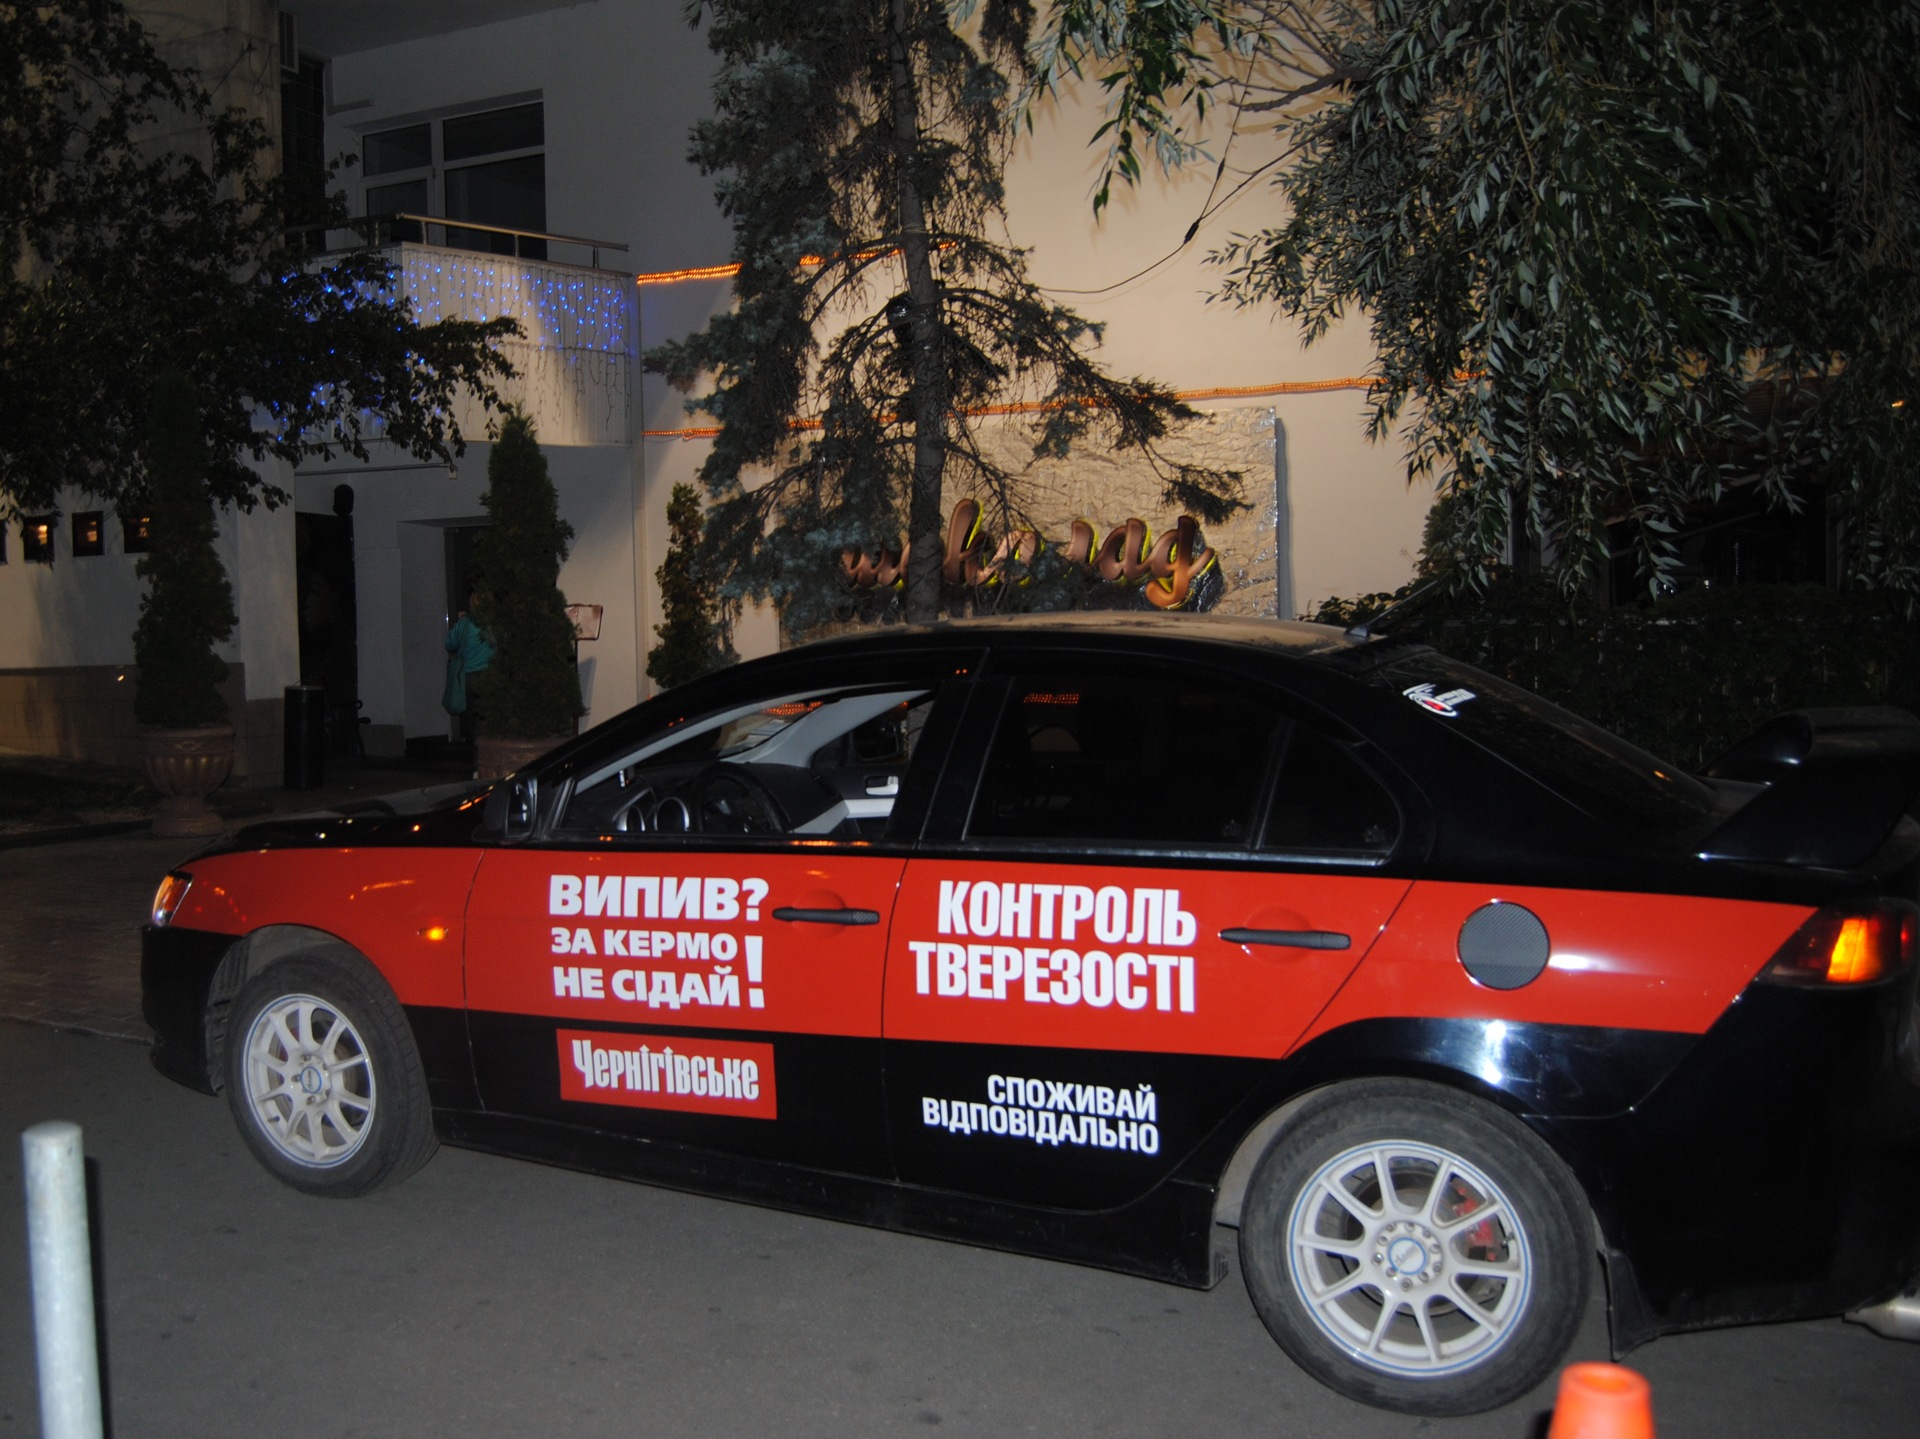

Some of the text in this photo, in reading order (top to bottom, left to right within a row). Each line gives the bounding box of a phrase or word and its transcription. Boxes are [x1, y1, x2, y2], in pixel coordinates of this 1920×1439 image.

[549, 875, 770, 921] ВИПИВ?
[938, 880, 1196, 946] КОНТРОЛЬ
[551, 927, 738, 961] ЗА КЕРМО
[553, 967, 605, 998] НЕ
[612, 965, 740, 1009] СІДАЙ
[909, 941, 1195, 1012] ТВЕРЕЗОСТІ
[572, 1040, 760, 1100] Чернігівське
[987, 1074, 1156, 1121] СПОЖИВАЙ
[922, 1097, 1159, 1154] ВІДПОВІДАЛЬНО
